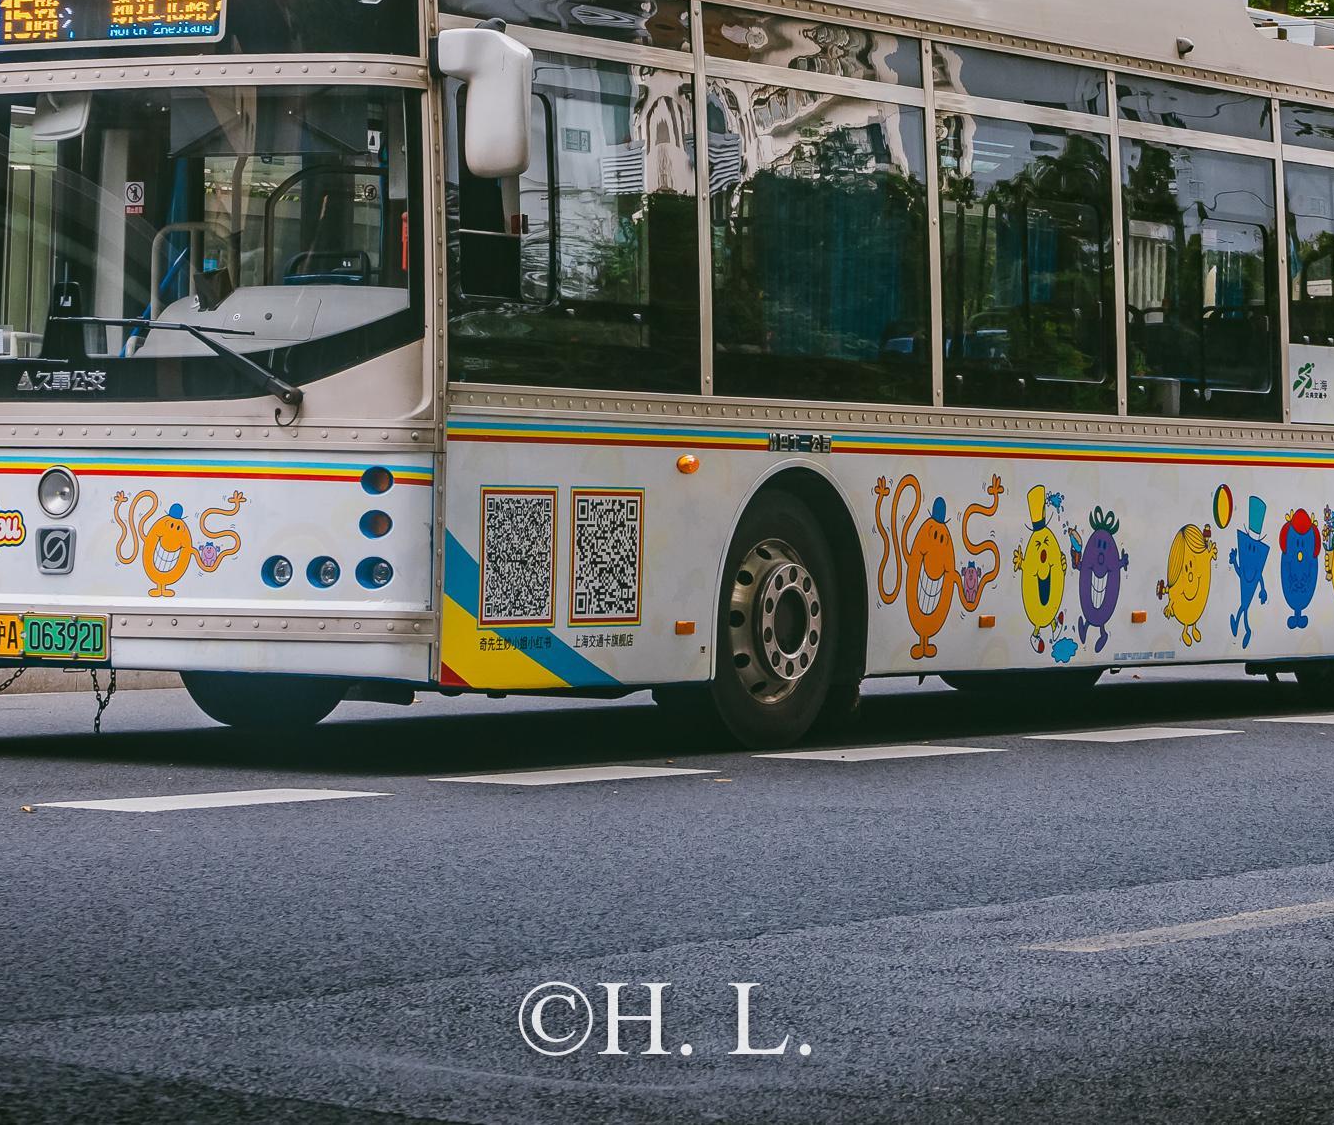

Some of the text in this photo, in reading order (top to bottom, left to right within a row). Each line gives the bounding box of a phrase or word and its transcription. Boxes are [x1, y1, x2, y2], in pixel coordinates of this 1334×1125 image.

[33, 370, 107, 391] 久事公交
[28, 620, 104, 653] 06392D
[479, 635, 553, 652] 奇先生妙小姐小红书
[572, 633, 635, 649] 上海交通卡旗舰店
